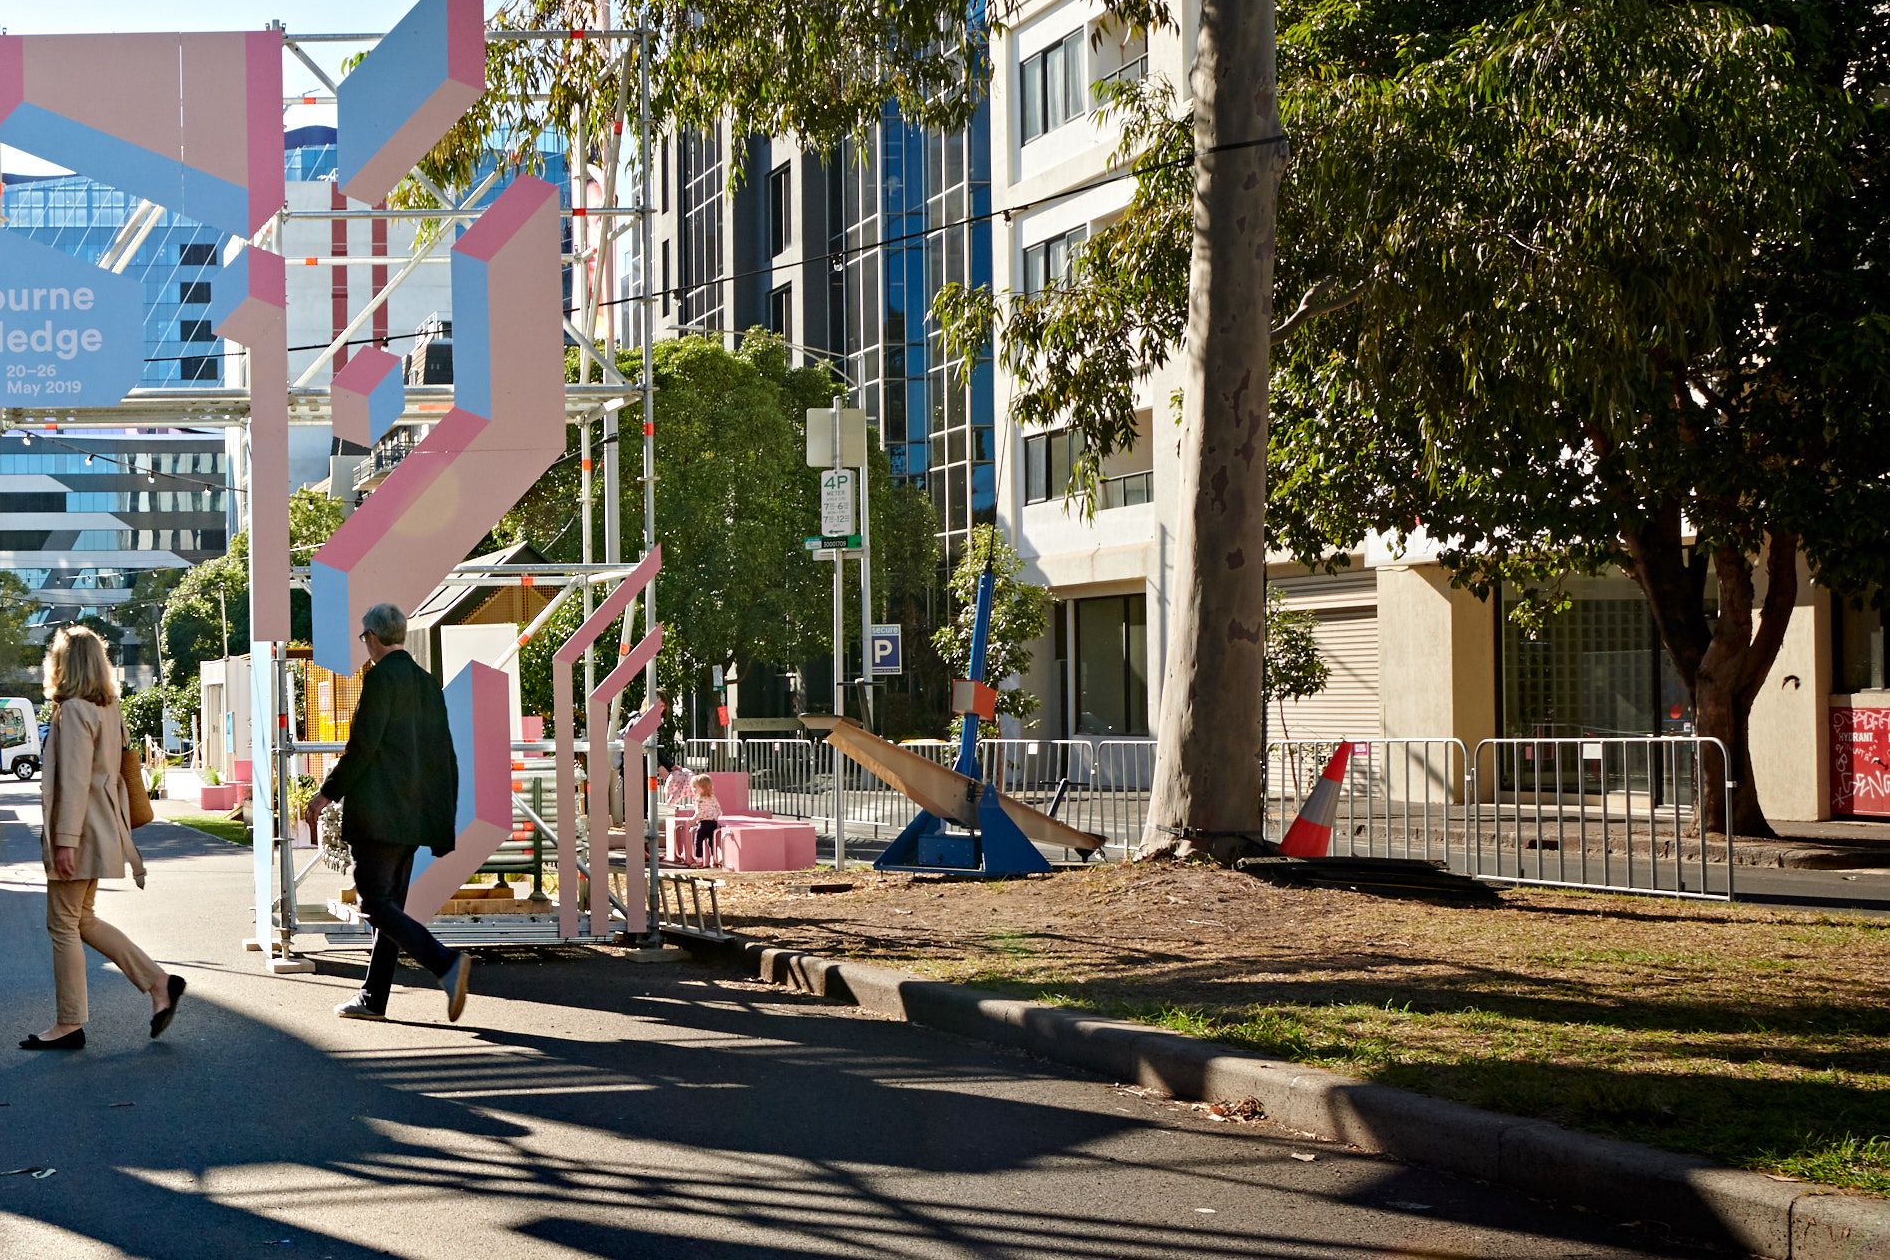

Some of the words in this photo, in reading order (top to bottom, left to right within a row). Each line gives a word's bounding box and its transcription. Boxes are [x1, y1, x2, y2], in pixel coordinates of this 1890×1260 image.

[6, 365, 56, 377] 20–26
[7, 381, 39, 397] May
[45, 380, 82, 394] 2019
[823, 475, 848, 489] 4P
[871, 626, 899, 634] secure
[874, 639, 893, 664] P
[1839, 732, 1874, 742] HYDRANT
